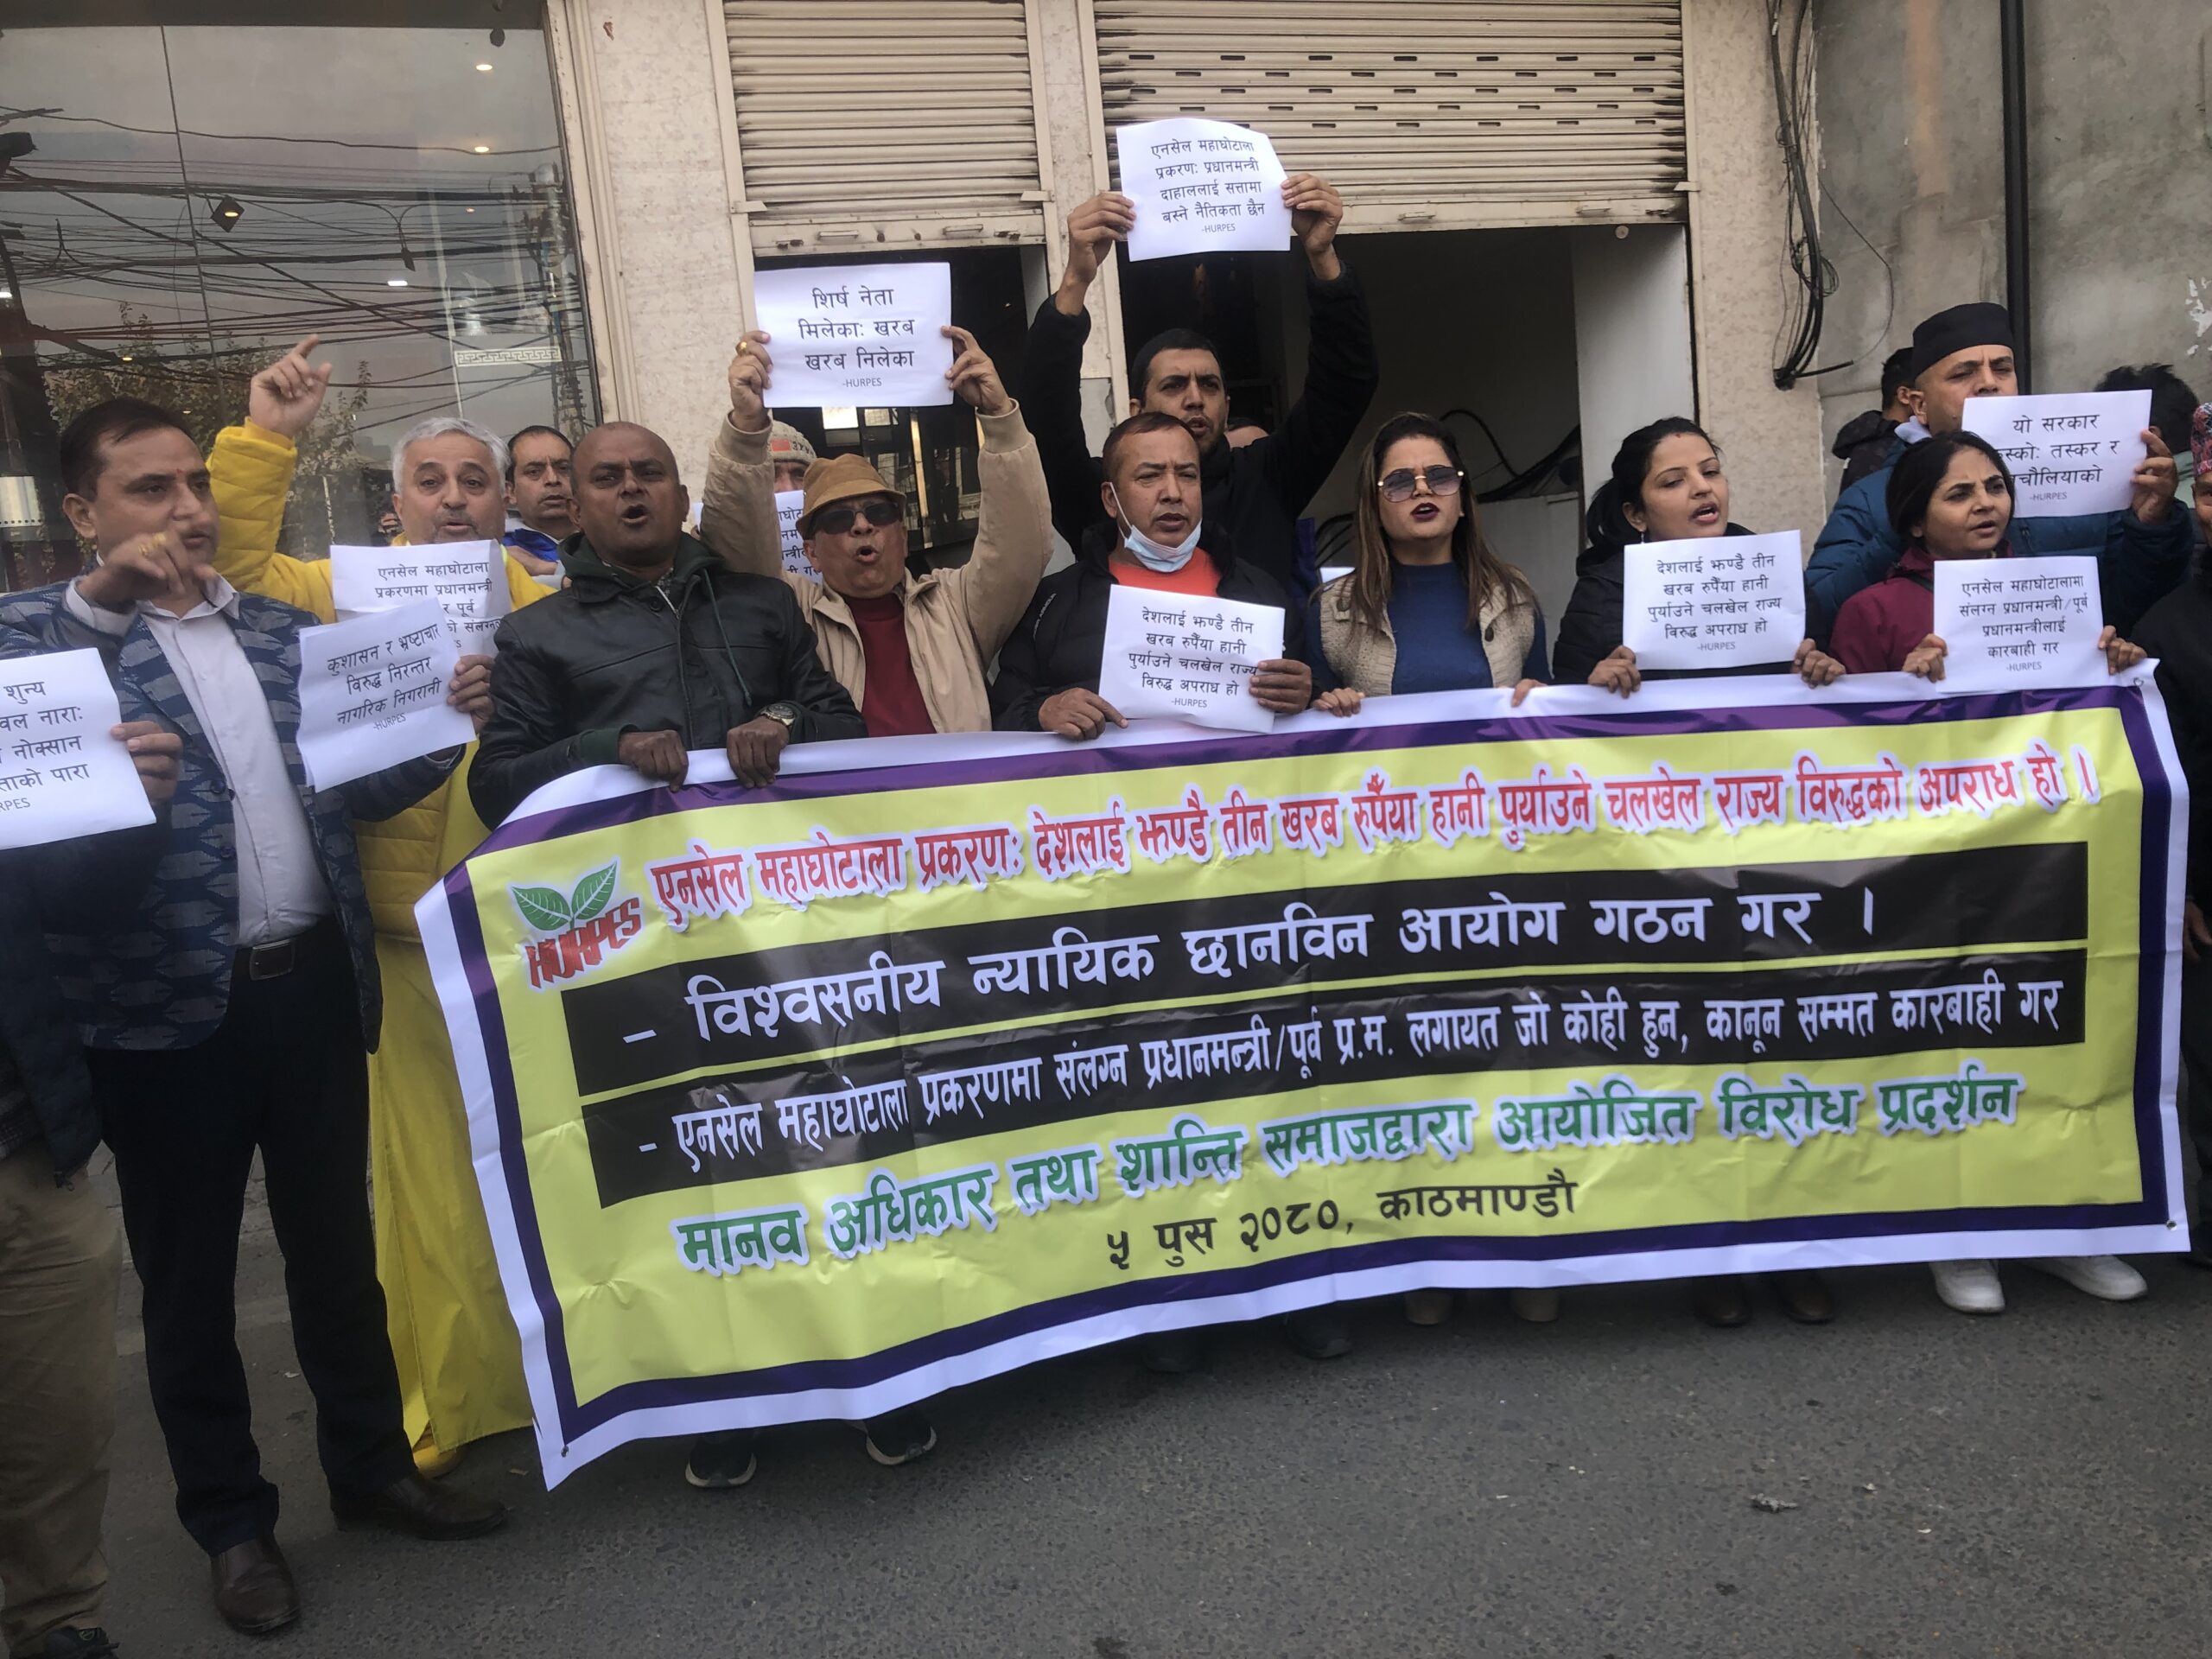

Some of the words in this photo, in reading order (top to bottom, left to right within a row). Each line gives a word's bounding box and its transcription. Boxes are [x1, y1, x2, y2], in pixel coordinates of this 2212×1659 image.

[1151, 138, 1192, 159] एनसेल
[1198, 137, 1255, 154] महाघोटाला
[1204, 157, 1260, 174] प्रधानमन्त्री
[1160, 179, 1219, 200] दाहाललाई
[1224, 181, 1262, 194] सत्तामा
[1162, 201, 1188, 223] बस्ने
[1195, 200, 1242, 219] नैतिकता
[1247, 198, 1265, 216] छैन
[1202, 223, 1236, 233] -HURPES
[812, 286, 849, 308] शिर्ष
[859, 285, 894, 306] नेता
[874, 319, 915, 336] खरब
[805, 353, 847, 371] खरब
[855, 346, 914, 369] निलेका
[842, 378, 882, 388] -HURPES
[2012, 415, 2033, 434] यो
[2042, 414, 2100, 432] सरकार
[2050, 442, 2101, 459] तस्कर
[2108, 440, 2120, 454] र
[2011, 465, 2103, 486] चौलियाको
[2030, 492, 2068, 502] -HURPES
[378, 563, 418, 581] एनसेल
[424, 561, 489, 577] महाघोटाला
[1656, 556, 1704, 575] देशलाई
[1711, 554, 1745, 571] झण्डै
[1751, 553, 1776, 569] तीन
[375, 585, 429, 599] प्रकरणमा
[435, 580, 493, 596] प्रधानमन्त्री
[1663, 583, 1694, 596] खरब
[1742, 575, 1770, 592] हानी
[1961, 578, 2004, 598] एनसेल
[2011, 575, 2083, 593] महाघोटालामा
[456, 599, 475, 617] पूर्व
[1700, 599, 1749, 614] चलखेल
[1755, 597, 1783, 611] राज्य
[1959, 602, 1997, 618] संलग्न
[1142, 607, 1187, 628] देशलाई
[1193, 613, 1225, 631] झण्डै
[1230, 617, 1255, 634] तीन
[1664, 624, 1698, 639] विरुद्ध
[1706, 623, 1748, 637] अपराध
[1754, 618, 1768, 634] हो
[1982, 615, 2067, 637] प्रधानमन्त्रीलाई
[327, 645, 380, 677] कुशासन
[386, 640, 393, 656] र
[398, 623, 442, 652] भ्रष्टाचार
[1146, 632, 1176, 647] खरब
[1220, 639, 1247, 655] हानी
[1987, 640, 2036, 658] कारबाही
[2043, 641, 2060, 654] गर
[346, 671, 383, 696] विरुद्ध
[388, 657, 433, 683] निरन्तर
[1179, 657, 1224, 673] चलखेल
[1230, 663, 1259, 677] राज्य
[3, 681, 47, 705] शुन्य
[1142, 672, 1173, 690] विरुद्ध
[1180, 679, 1220, 695] अपराध
[1226, 681, 1240, 696] हो
[337, 698, 388, 725] नागरिक
[393, 677, 442, 709] निगरानी
[1171, 698, 1208, 709] -HURPES
[0, 713, 29, 733] वल
[373, 713, 407, 730] -HURPES
[11, 734, 82, 760] नोक्सान
[0, 768, 43, 792] ताको
[50, 763, 91, 782] पारा
[652, 844, 747, 925] एनसेल
[755, 831, 902, 906] महाघोटाला
[1033, 801, 1126, 875] देशलाई
[1136, 789, 1209, 857] झण्डै
[1220, 790, 1268, 854] तीन
[1280, 798, 1340, 851] खरब
[1430, 772, 1486, 842] हानी
[1605, 766, 1701, 824] चलखेल
[1713, 775, 1783, 828] राज्य
[1796, 755, 1903, 822] विरुद्धको
[1917, 760, 2015, 812] अपराध
[2027, 743, 2060, 807] हो
[524, 896, 643, 988] HURPES
[683, 950, 946, 1042] विश्वसनीय
[967, 926, 1160, 995] न्यायिक
[1180, 901, 1375, 979] छानविन
[1400, 891, 1567, 954] आयोग
[1588, 898, 1713, 944] गठन
[1737, 893, 1822, 944] गर
[671, 1094, 764, 1173] एनसेल
[775, 1075, 909, 1151] महाघोटाला
[918, 1057, 1045, 1126] प्रकरणमा
[1054, 1040, 1128, 1098] संलग्न
[1406, 1005, 1502, 1058] लगायत
[1512, 991, 1552, 1048] जो
[1561, 985, 1629, 1052] कोही
[1640, 1000, 1688, 1059] हुन,
[1704, 997, 1785, 1053] कानून
[1796, 991, 1878, 1044] सम्मत
[1890, 968, 2006, 1035] कारबाही
[2018, 980, 2064, 1032] गर
[677, 1209, 806, 1269] मानव
[829, 1173, 995, 1253] अधिकार
[1011, 1148, 1097, 1209] तथा
[1116, 1118, 1243, 1191] शान्ति
[1262, 1102, 1475, 1172] समाजद्वारा
[1497, 1079, 1697, 1147] आयोजित
[1719, 1077, 1859, 1141] विरोध
[1878, 1064, 2019, 1128] प्रदर्शन
[1153, 1217, 1218, 1268] पुस
[1376, 1167, 1580, 1221] काठमाण्डौ
